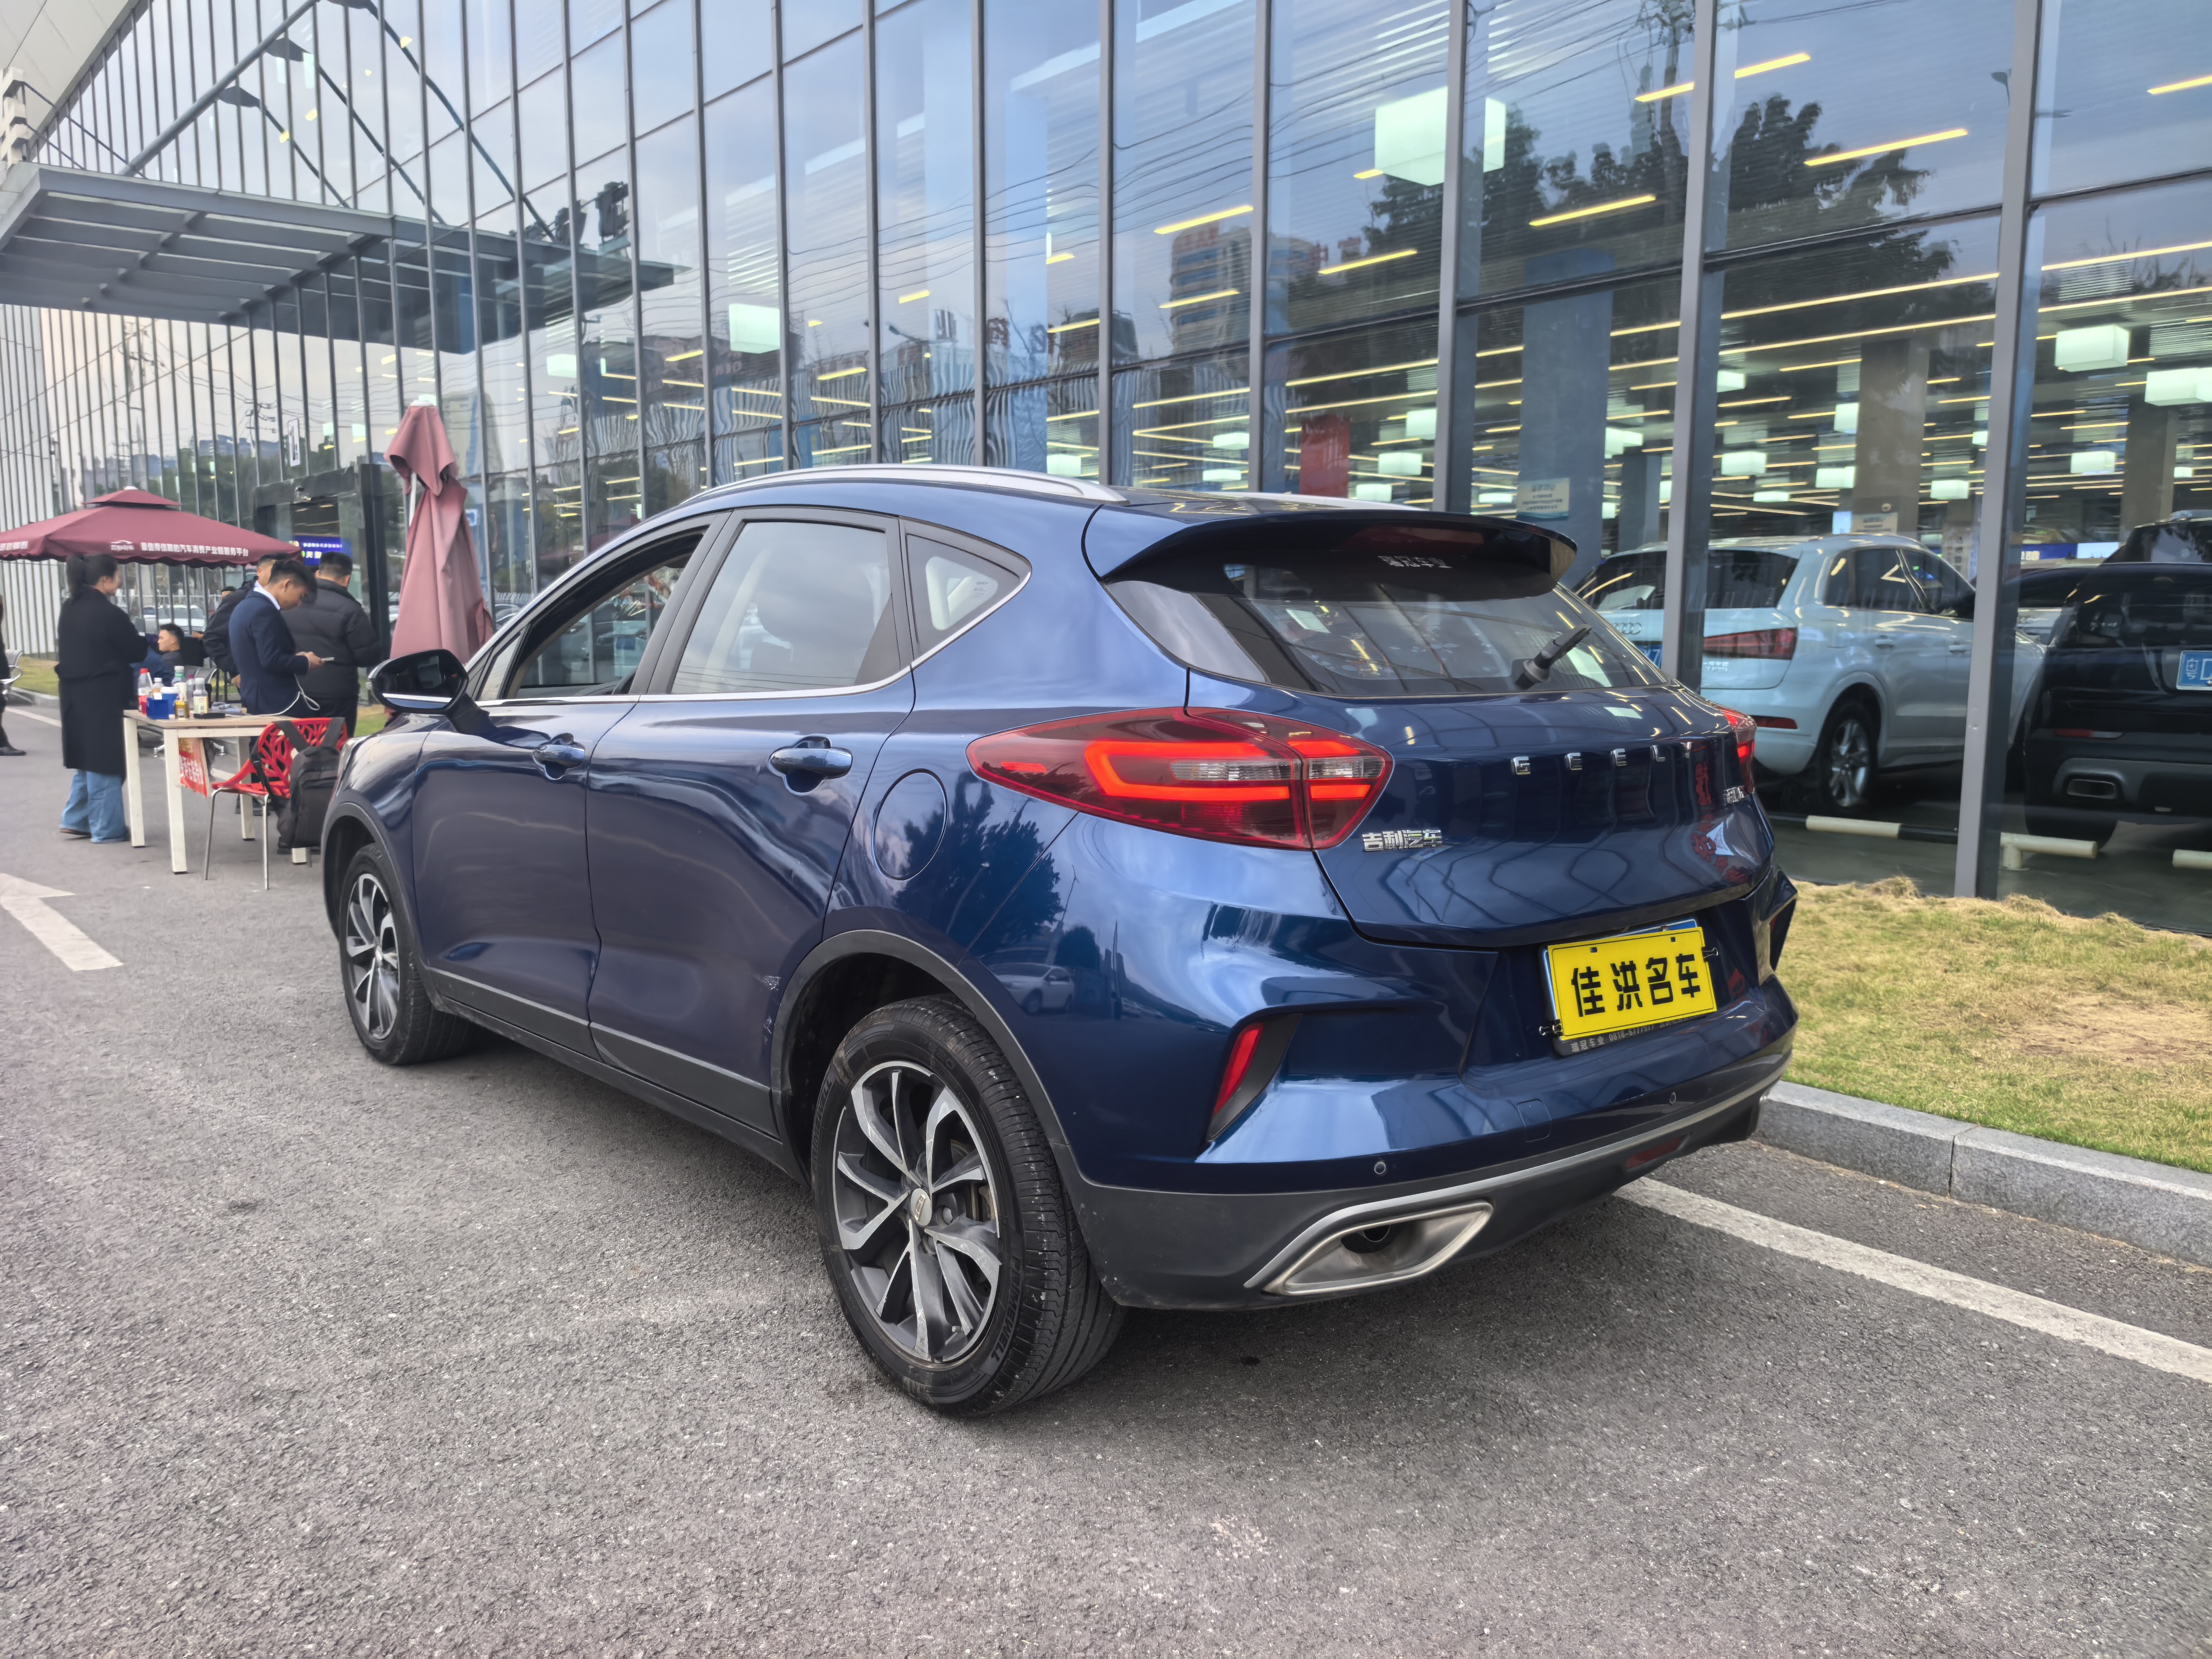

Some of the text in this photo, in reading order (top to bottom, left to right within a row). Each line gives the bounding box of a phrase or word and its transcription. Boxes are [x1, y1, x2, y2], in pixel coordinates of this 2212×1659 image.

[1510, 741, 1692, 775] GEELY
[1363, 830, 1443, 851] 吉利汽车
[1571, 954, 1701, 1017] 佳洪名车
[991, 1255, 1020, 1362] PRIMEWELL
